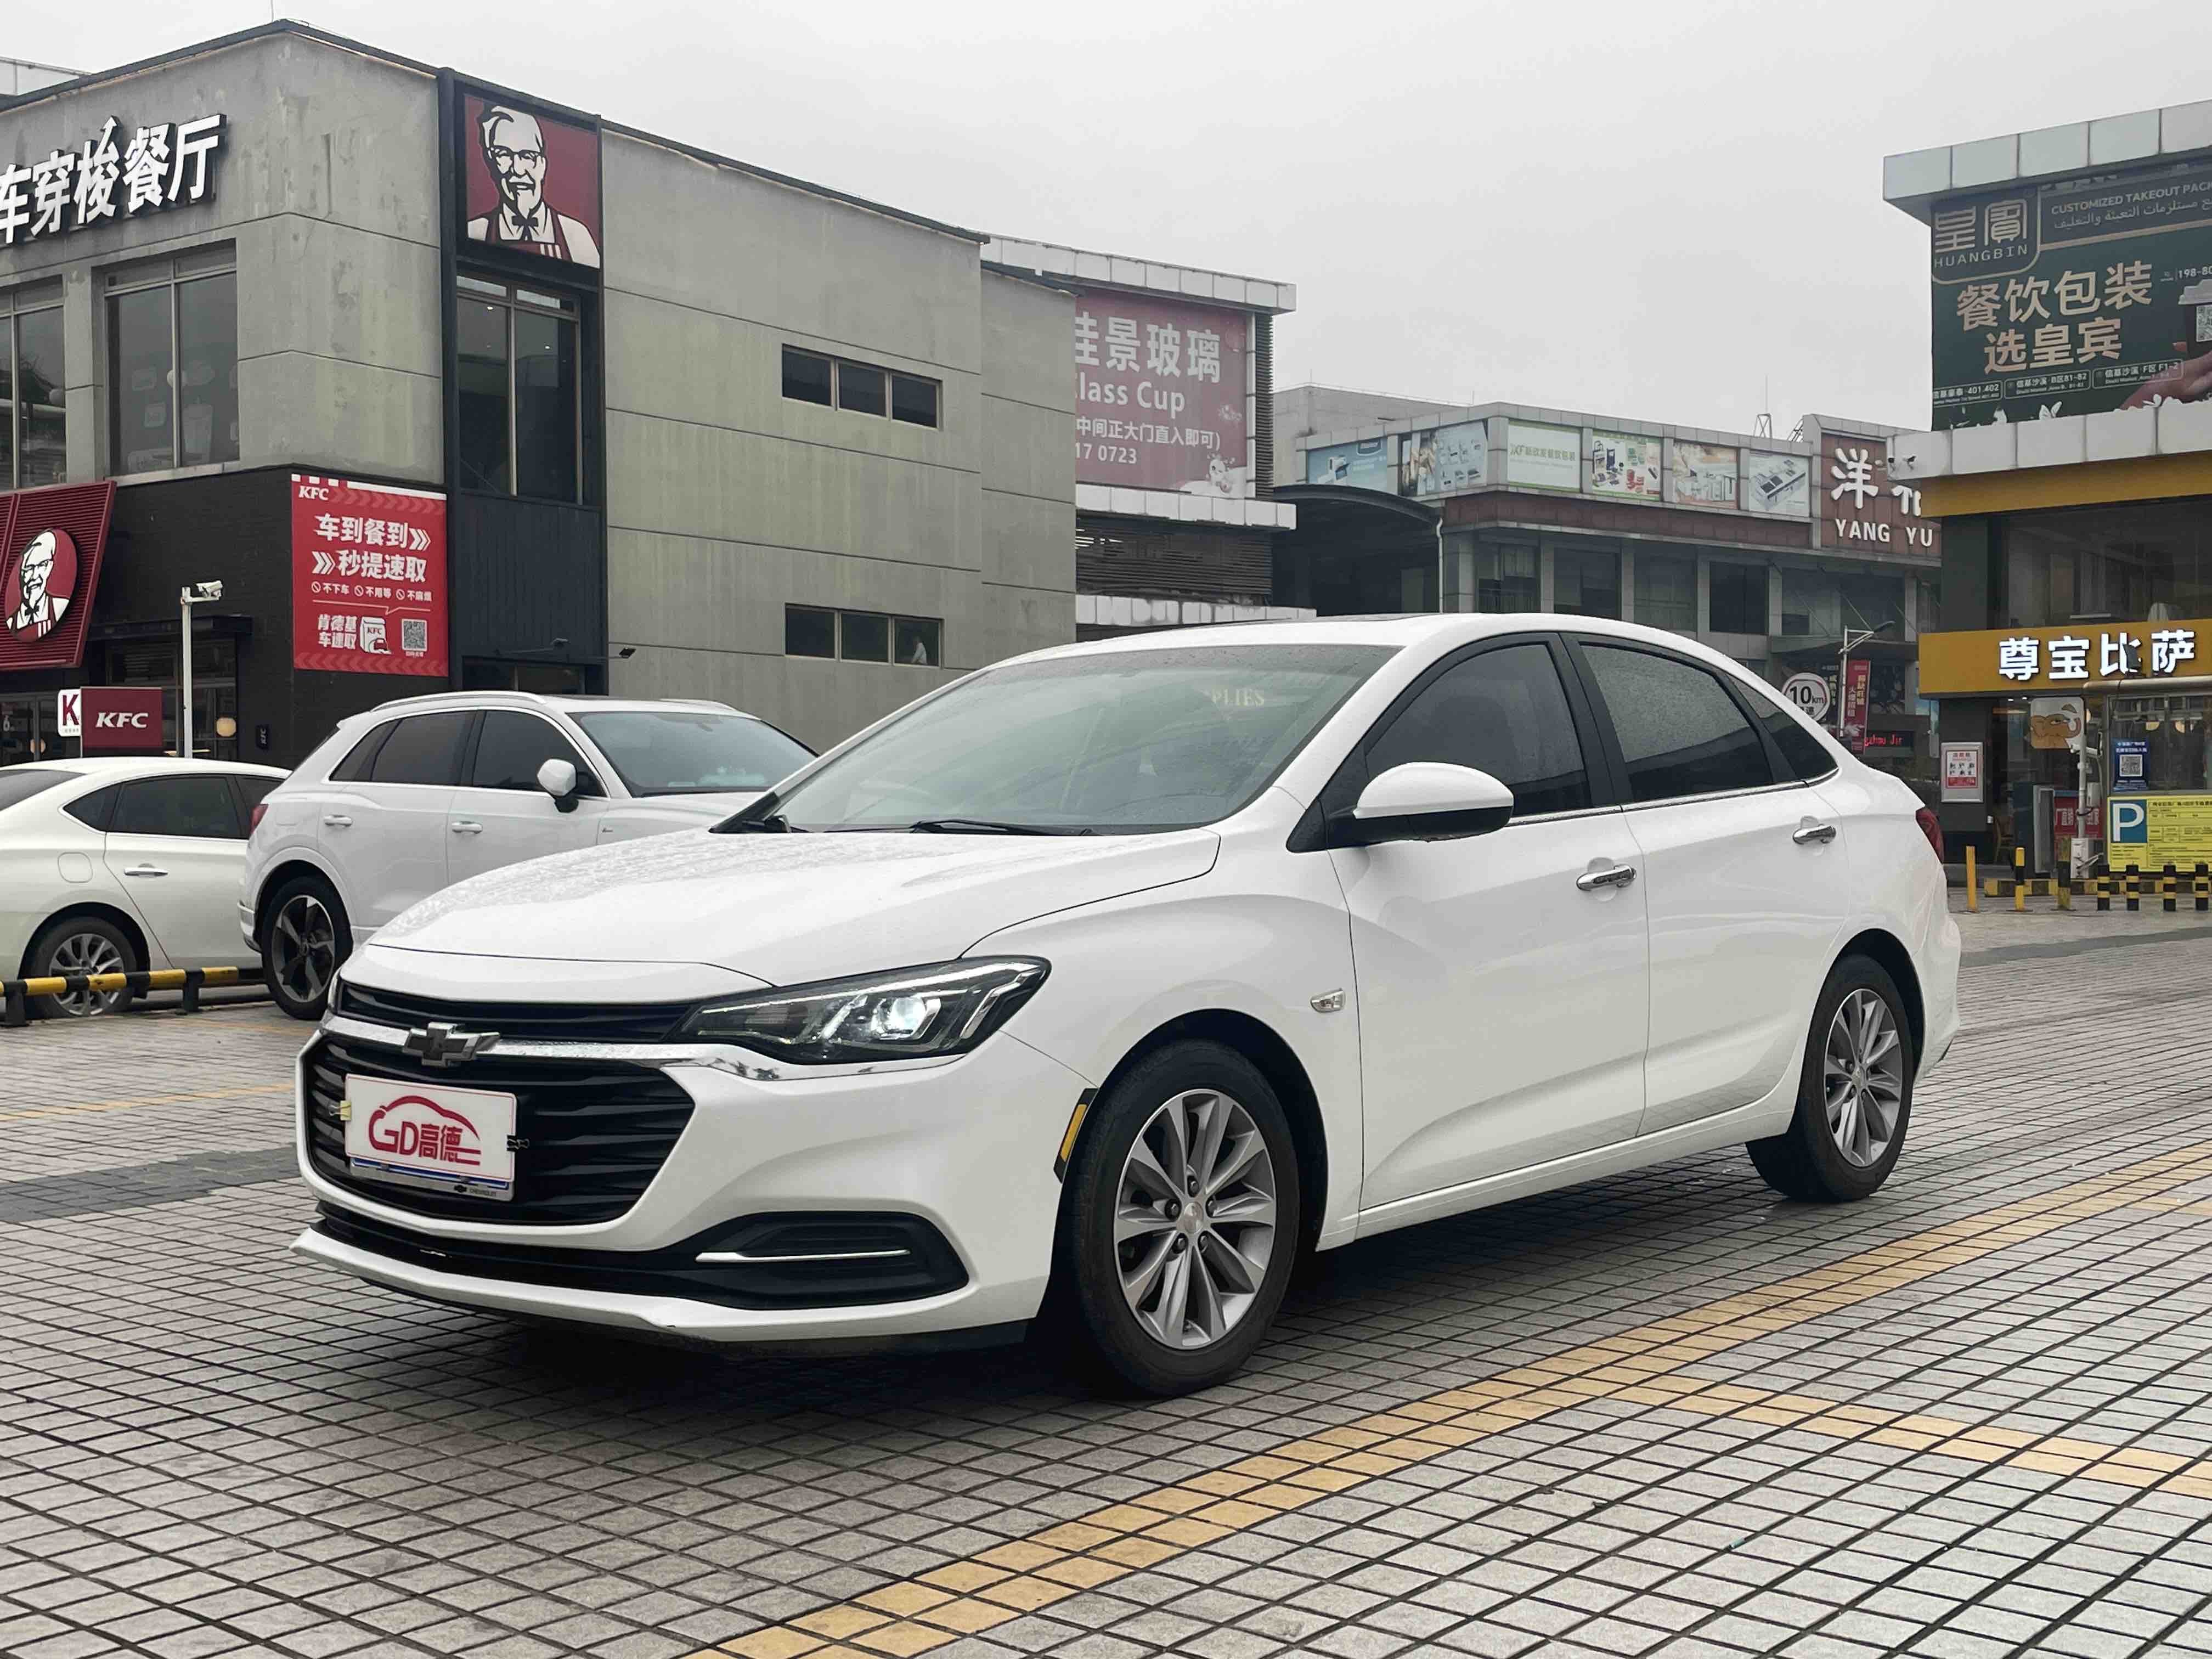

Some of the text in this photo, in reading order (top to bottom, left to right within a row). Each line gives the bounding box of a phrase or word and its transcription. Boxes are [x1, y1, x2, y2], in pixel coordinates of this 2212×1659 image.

[0, 115, 221, 244] 车穿梭餐厅
[2051, 195, 2123, 215] CUSTOMIZED
[2125, 186, 2181, 202] TAKEOUT
[1934, 244, 2028, 268] HUANGBIN
[1956, 261, 2152, 331] 餐饮包装
[1984, 317, 2122, 374] 选皇宾
[1075, 372, 1185, 419] lass Cup
[1098, 445, 1137, 464] 0723
[298, 486, 329, 500] KFC
[314, 513, 408, 549] 车到餐到
[1835, 518, 1933, 547] YANG YU
[337, 549, 427, 583] 秒提速取
[323, 582, 349, 595] 不下车
[365, 586, 392, 599] 不用等
[318, 613, 358, 633] 肯德基
[367, 627, 382, 635] KFC
[1999, 629, 2195, 681] 尊宝比萨
[1790, 685, 1824, 704] 10 km
[63, 694, 80, 726] K
[95, 712, 149, 729] KFC
[2113, 803, 2145, 842] P
